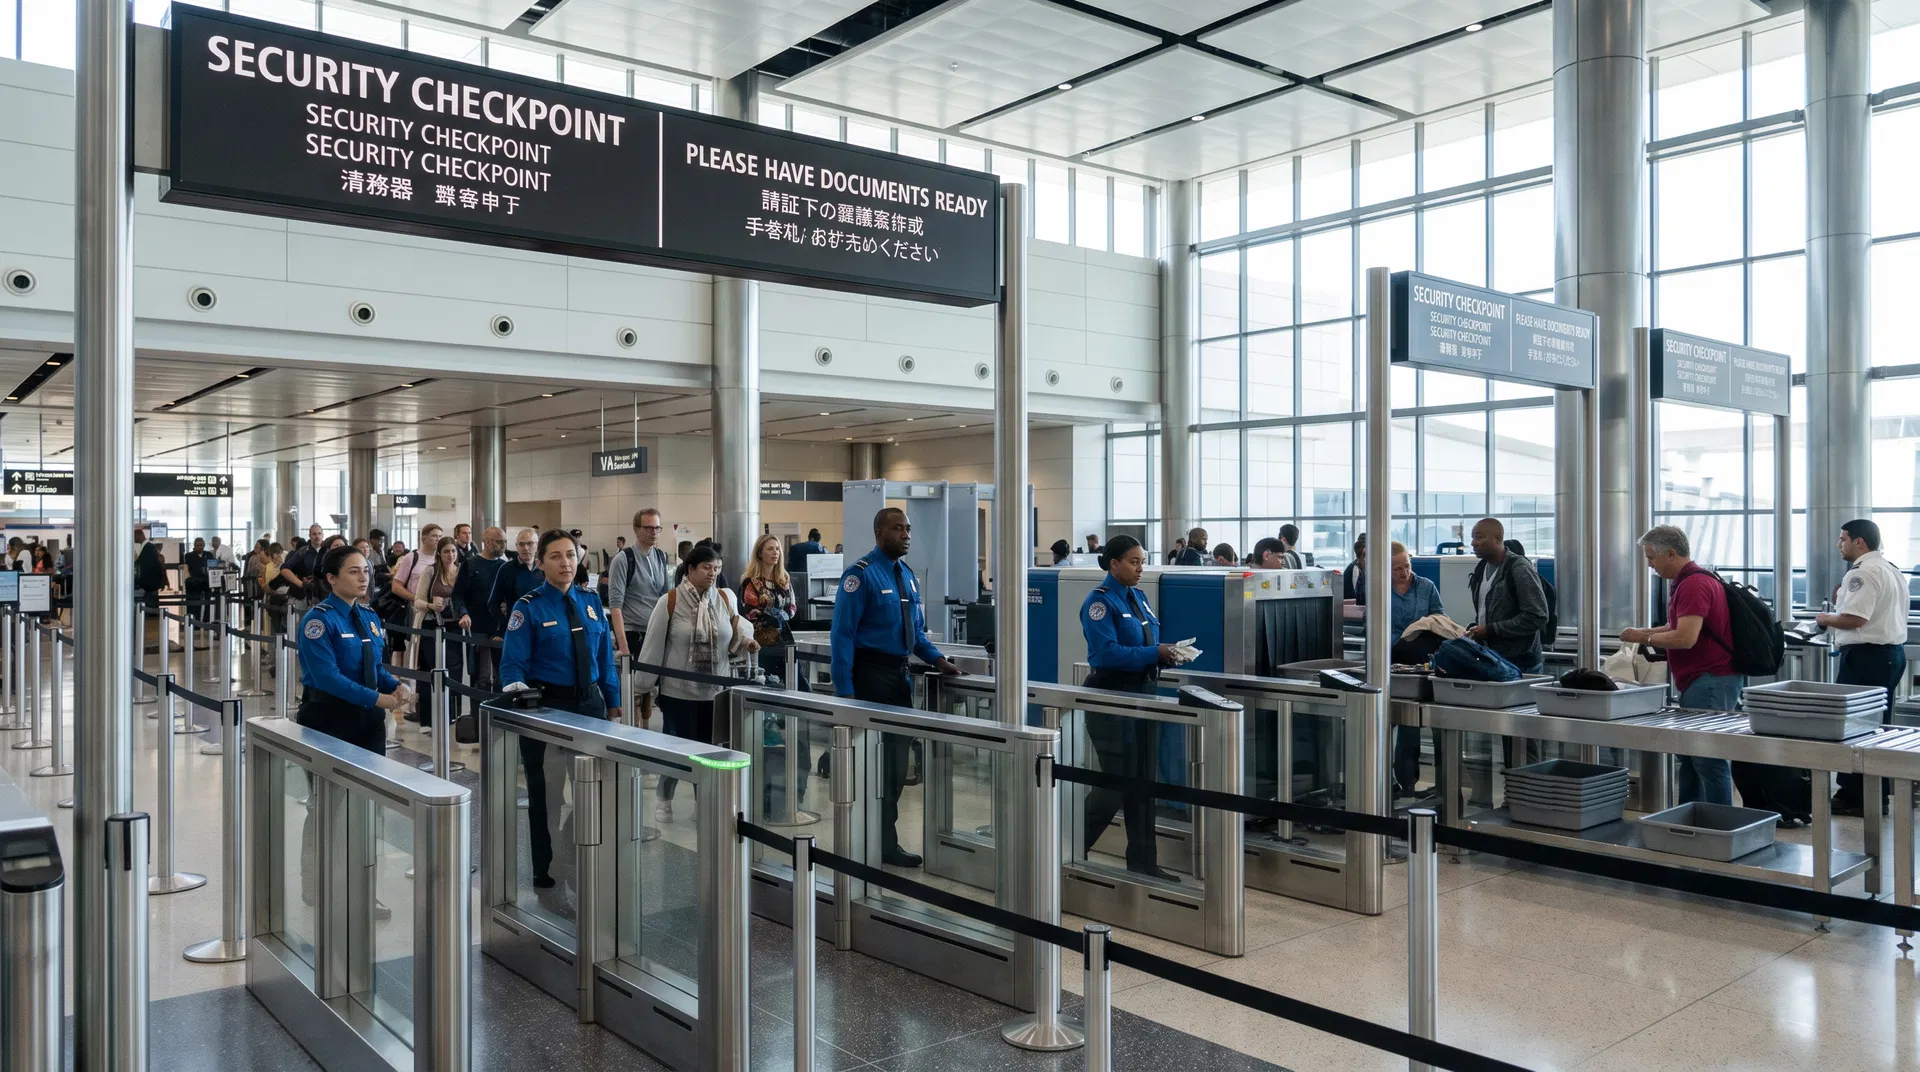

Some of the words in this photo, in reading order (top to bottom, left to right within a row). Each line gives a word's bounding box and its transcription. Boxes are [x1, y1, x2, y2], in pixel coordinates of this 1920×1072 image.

[208, 36, 399, 103] SECURITY
[412, 77, 625, 146] CHECKPOINT
[307, 103, 414, 140] SECURITY
[421, 124, 551, 164] CHECKPOINT
[307, 133, 414, 169] SECURITY
[421, 153, 551, 191] CHECKPOINT
[687, 143, 758, 176] PLEASE
[766, 158, 814, 187] HAVE
[821, 169, 929, 207] DOCUMENTS
[936, 190, 988, 218] READY
[1413, 285, 1454, 309] SECURITY
[1455, 295, 1505, 320] CHECKPOINT
[600, 455, 614, 471] VA
